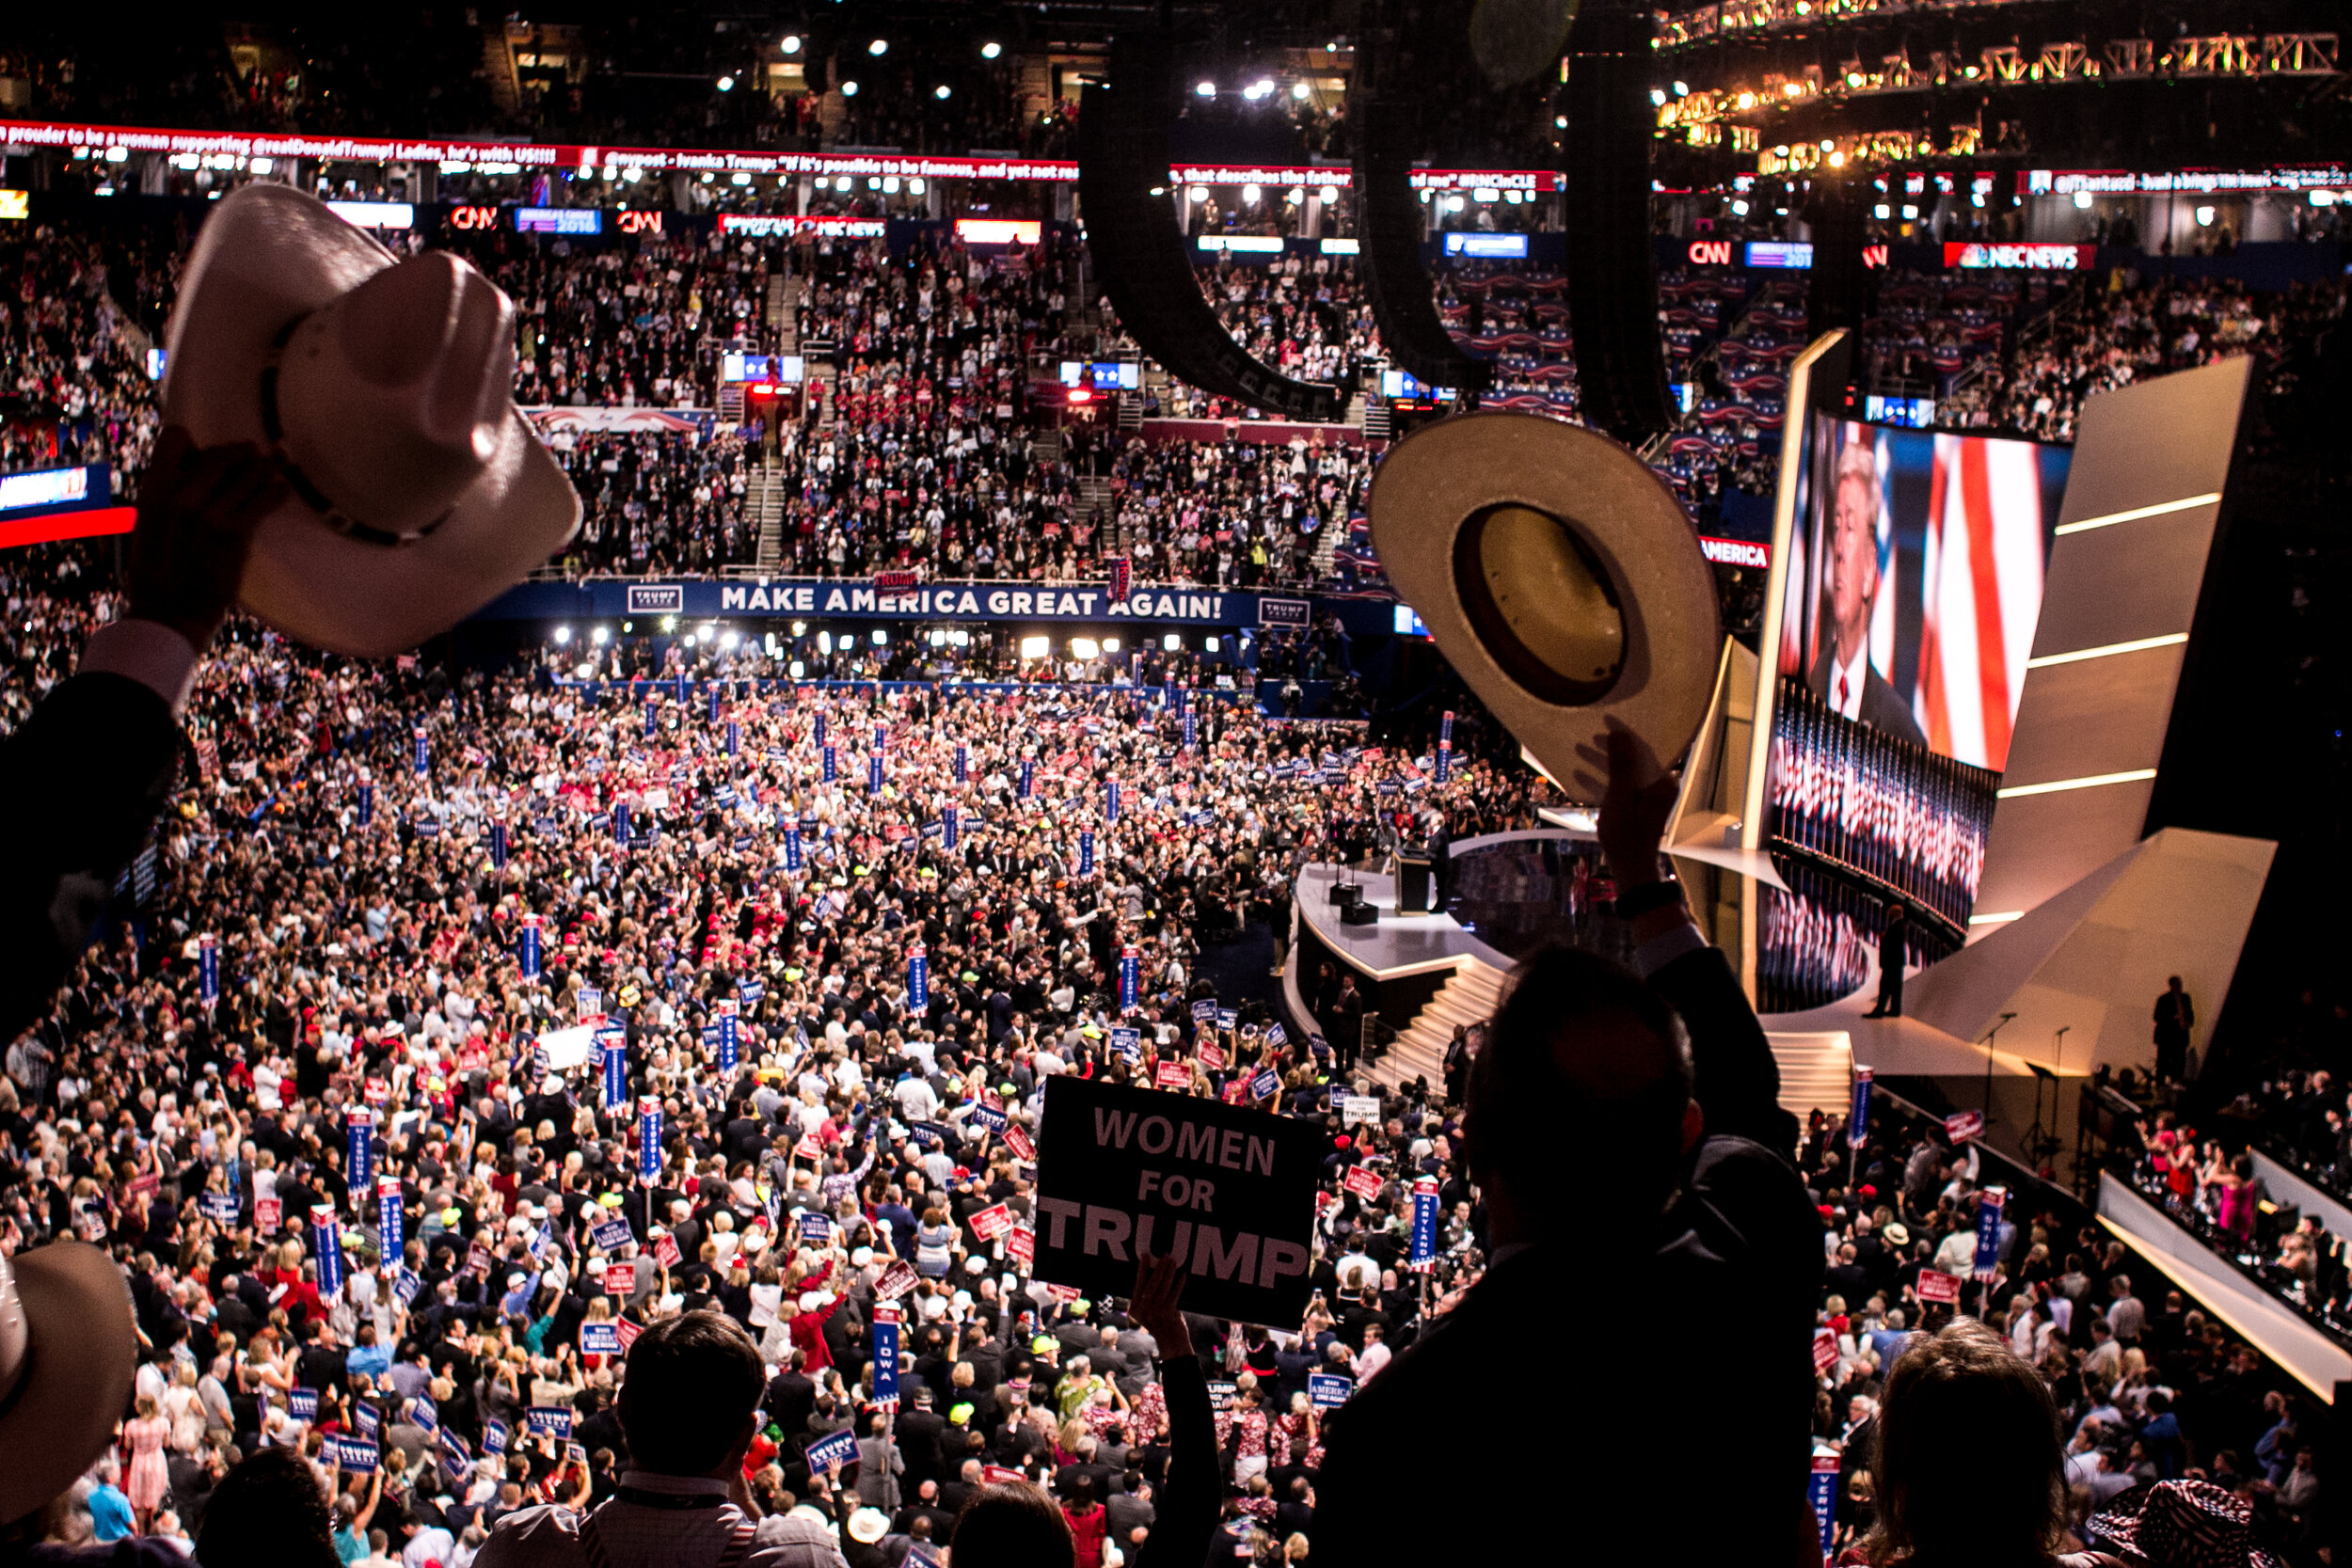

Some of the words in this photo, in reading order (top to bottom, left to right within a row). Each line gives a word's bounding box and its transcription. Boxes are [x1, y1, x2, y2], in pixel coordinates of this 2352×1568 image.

[8, 125, 66, 145] prouder
[67, 128, 85, 145] to
[86, 128, 104, 146] be
[106, 132, 116, 147] a
[118, 133, 169, 150] woman
[171, 135, 251, 156] supporting
[252, 137, 394, 162] @realDonaldTrump!
[395, 143, 446, 161] Ladies,
[448, 145, 477, 161] he's
[479, 147, 513, 162] with
[605, 150, 667, 169] @nypost
[676, 153, 724, 168] Ivanka
[725, 154, 777, 173] Trump:
[823, 158, 882, 175] possible
[882, 160, 898, 174] to
[900, 160, 919, 174] be
[920, 160, 977, 179] famous,
[977, 163, 1006, 178] and
[1007, 165, 1031, 181] yet
[1031, 166, 1058, 179] not
[1184, 168, 1216, 182] that
[1216, 169, 1279, 184] describes
[1280, 170, 1305, 184] the
[1306, 170, 1351, 186] father
[452, 206, 497, 230] CNN
[617, 211, 662, 233] CNN
[847, 222, 885, 237] NEWS
[1689, 241, 1731, 265] CNN
[2026, 245, 2077, 269] NEWS
[722, 587, 815, 610] MAKE
[825, 589, 980, 614] AMERICA
[988, 592, 1098, 616] GREAT
[1107, 594, 1222, 620] AGAIN!
[1266, 604, 1304, 612] TRUMP
[649, 1115, 658, 1169] GEORGIA
[1094, 1106, 1276, 1177] WOMEN
[1137, 1169, 1215, 1212] FOR
[380, 1198, 390, 1260] AMERICAN
[391, 1203, 402, 1243] SAMOA
[1038, 1195, 1310, 1290] TRUMP
[1420, 1196, 1431, 1257] MARYLAND
[1980, 1214, 1993, 1252] OHIO
[881, 1335, 892, 1382] IOWA
[1311, 1385, 1351, 1398] AMERICA
[810, 1437, 852, 1461] TRUMP
